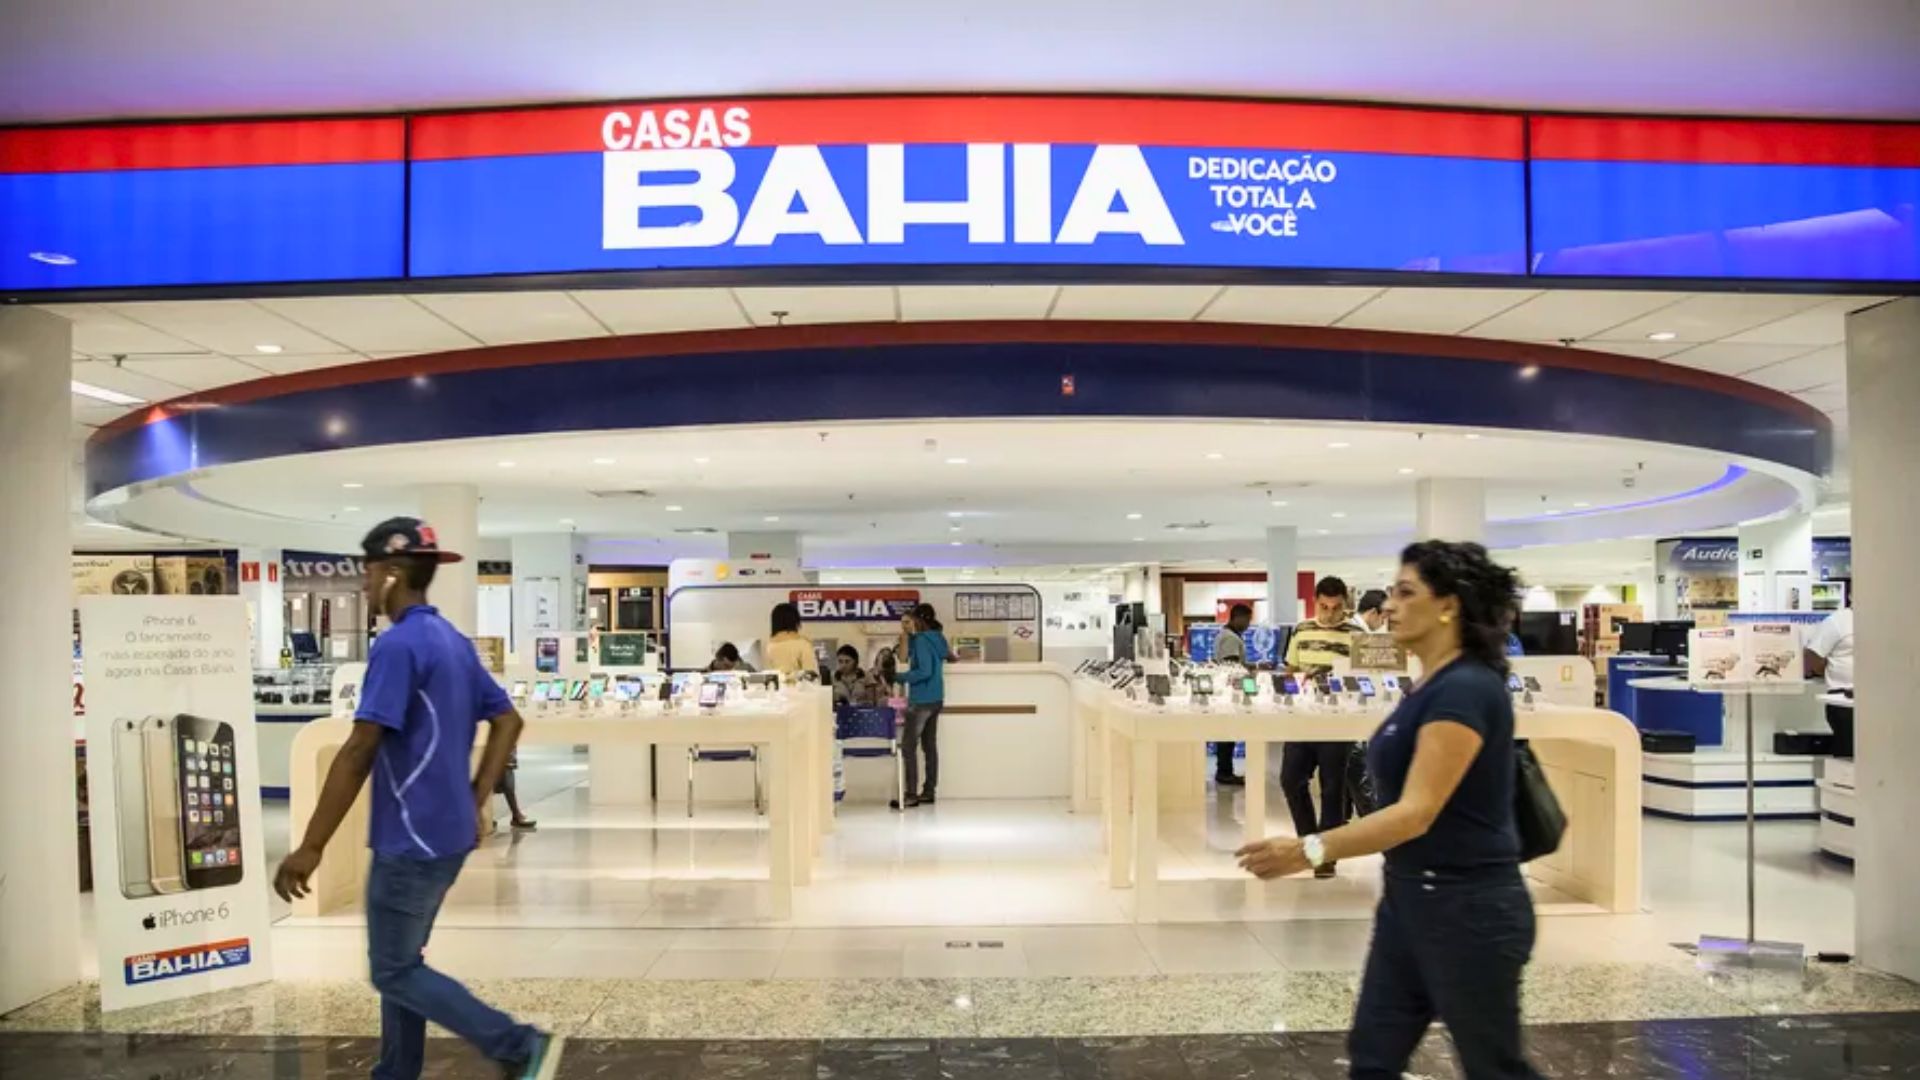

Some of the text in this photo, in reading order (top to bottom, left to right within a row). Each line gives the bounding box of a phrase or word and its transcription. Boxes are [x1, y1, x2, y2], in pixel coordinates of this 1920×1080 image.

[602, 107, 751, 150] CASAS
[1188, 154, 1337, 185] DEDICAÇÃO
[602, 143, 1186, 250] BAHIA
[1209, 185, 1317, 210] TOTAL A
[1227, 209, 1298, 236] VOCÊ
[798, 600, 890, 617] BAHIA
[160, 901, 230, 927] iPhone 6
[132, 949, 226, 980] BAHIA
